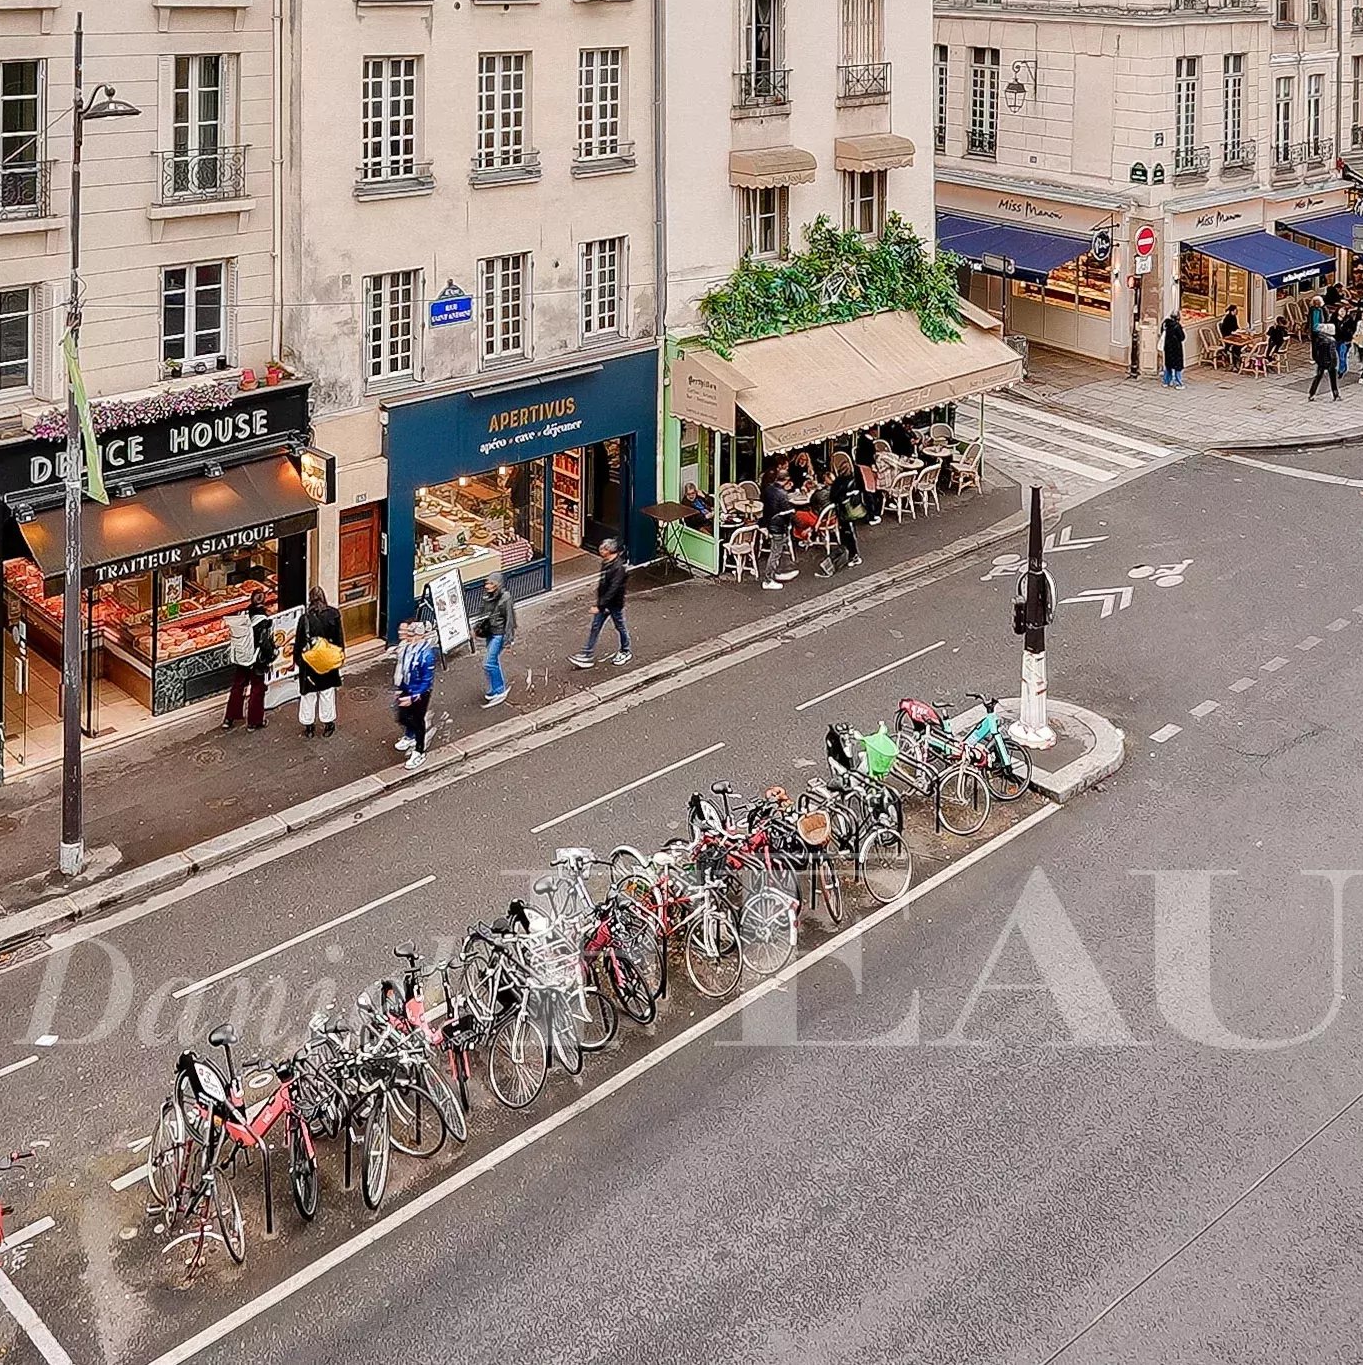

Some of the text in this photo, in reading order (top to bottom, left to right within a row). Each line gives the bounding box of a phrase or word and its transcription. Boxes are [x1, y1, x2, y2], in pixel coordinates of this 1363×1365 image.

[998, 198, 1063, 219] Miss Manon
[169, 409, 269, 454] HOUSE
[488, 397, 576, 433] APERTIVUS
[514, 431, 536, 444] cave
[95, 523, 275, 582] TRAITEUR ASIATIQUE
